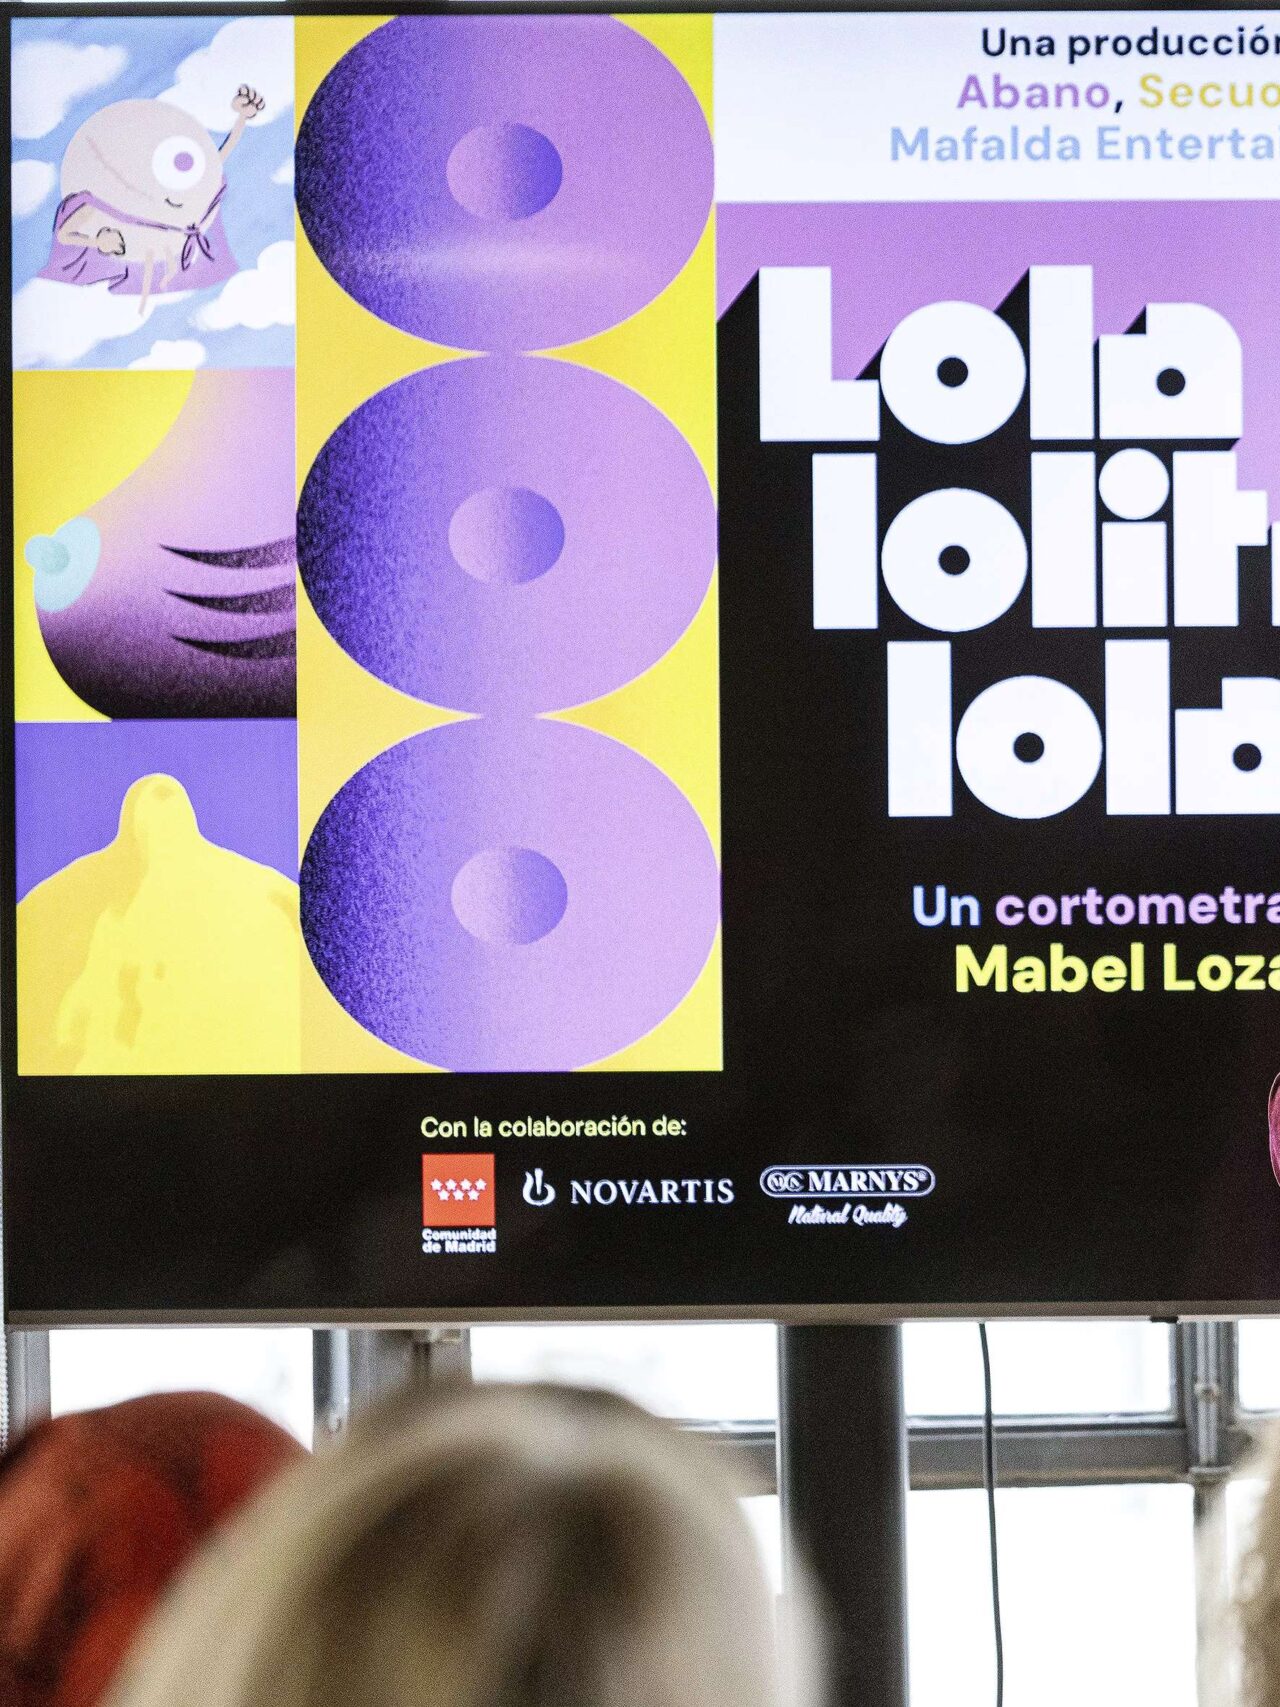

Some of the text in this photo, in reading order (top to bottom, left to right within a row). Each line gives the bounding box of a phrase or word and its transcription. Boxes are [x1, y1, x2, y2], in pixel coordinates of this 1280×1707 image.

[983, 27, 1055, 57] Una
[956, 74, 1124, 114] Abano,
[890, 125, 1081, 162] Mafalda
[758, 265, 1243, 445] Lola
[913, 884, 981, 927] Un
[955, 942, 1145, 993] Mabel
[420, 1114, 688, 1138] Con la colaboración de:
[570, 1178, 735, 1206] NOVARTIS
[421, 1227, 497, 1241] Comunidad
[421, 1239, 497, 1254] de Madrid
